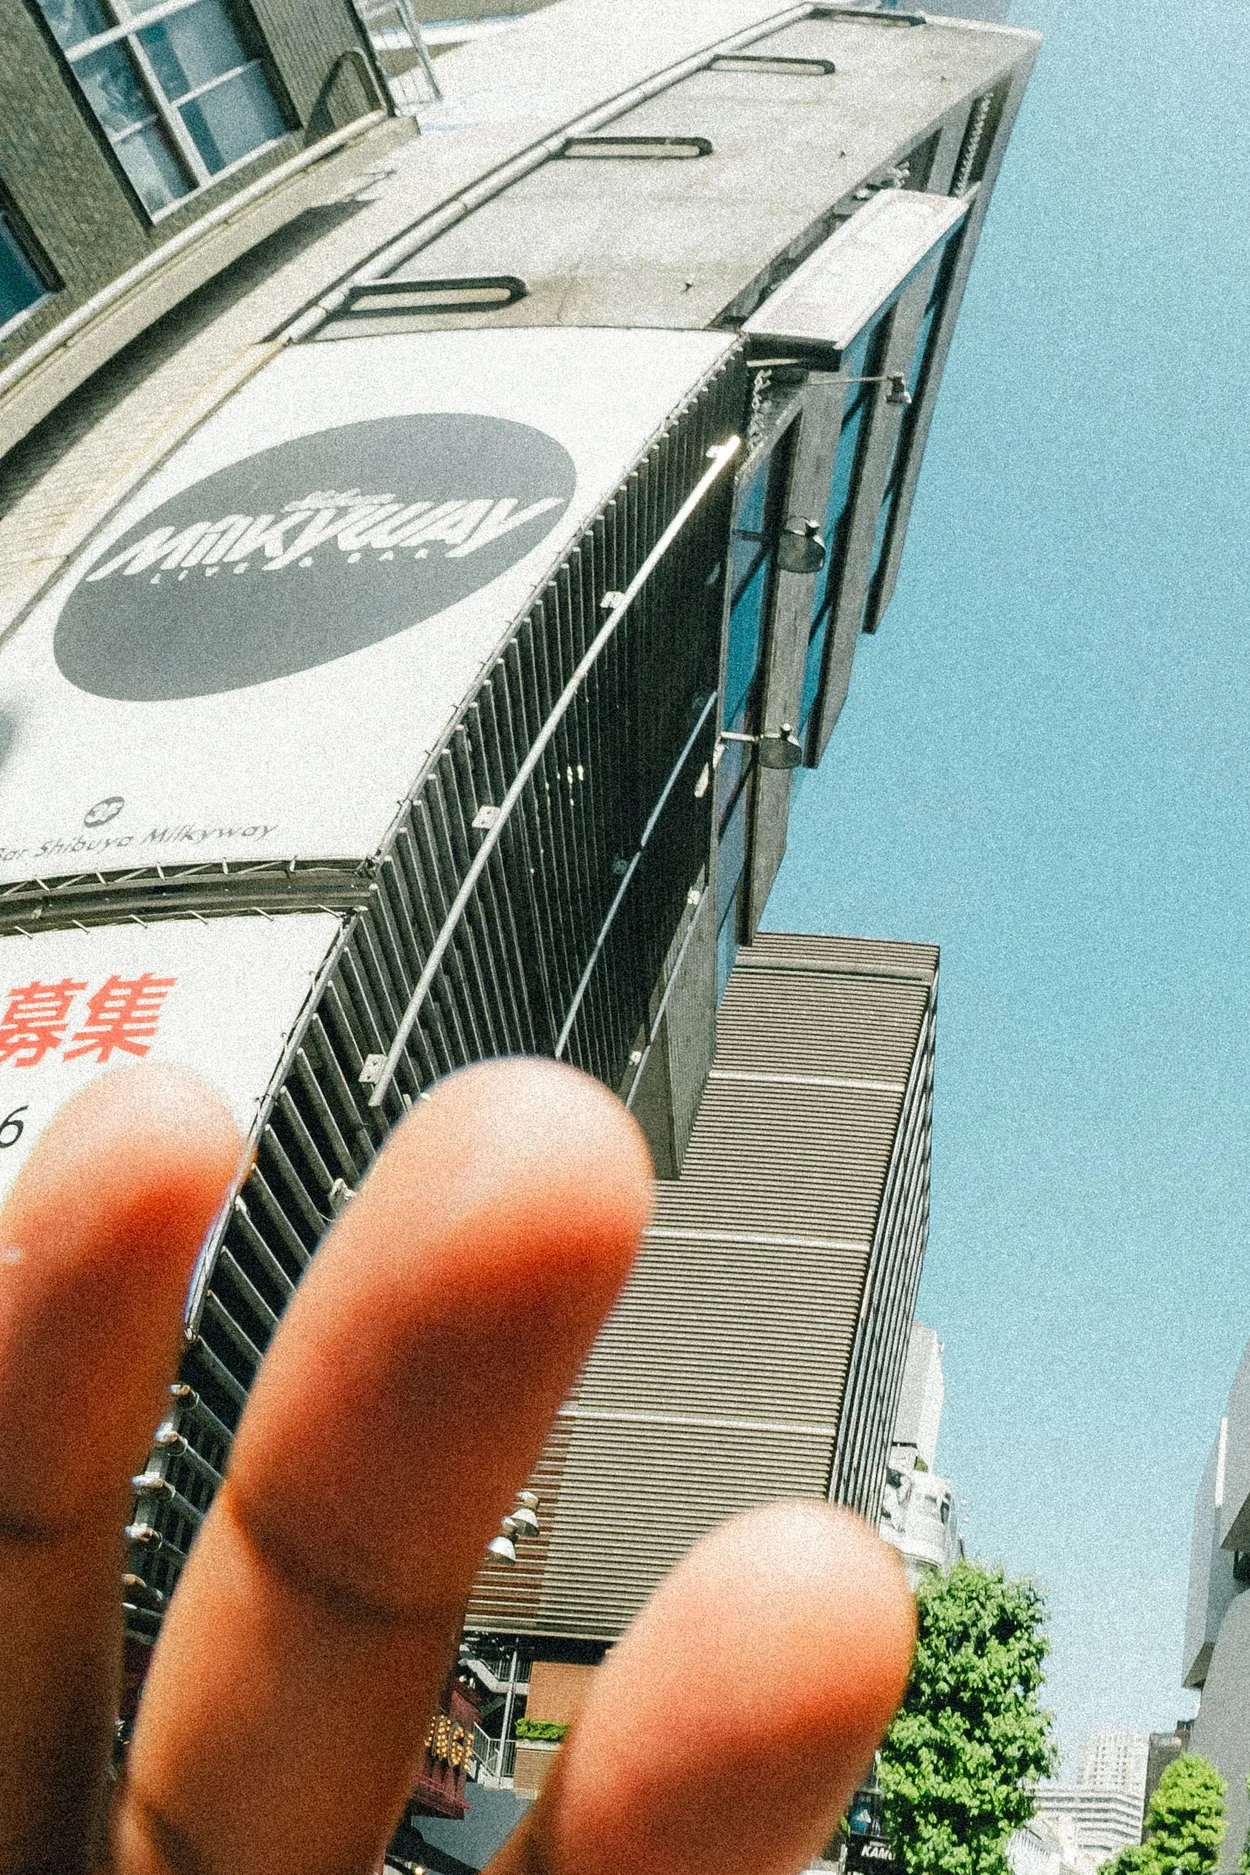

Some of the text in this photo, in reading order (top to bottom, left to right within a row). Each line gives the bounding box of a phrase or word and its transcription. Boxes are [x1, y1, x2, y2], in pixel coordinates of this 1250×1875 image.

[34, 836, 134, 859] Shibuya
[140, 822, 278, 846] Milkyway
[0, 971, 177, 1067] 募集
